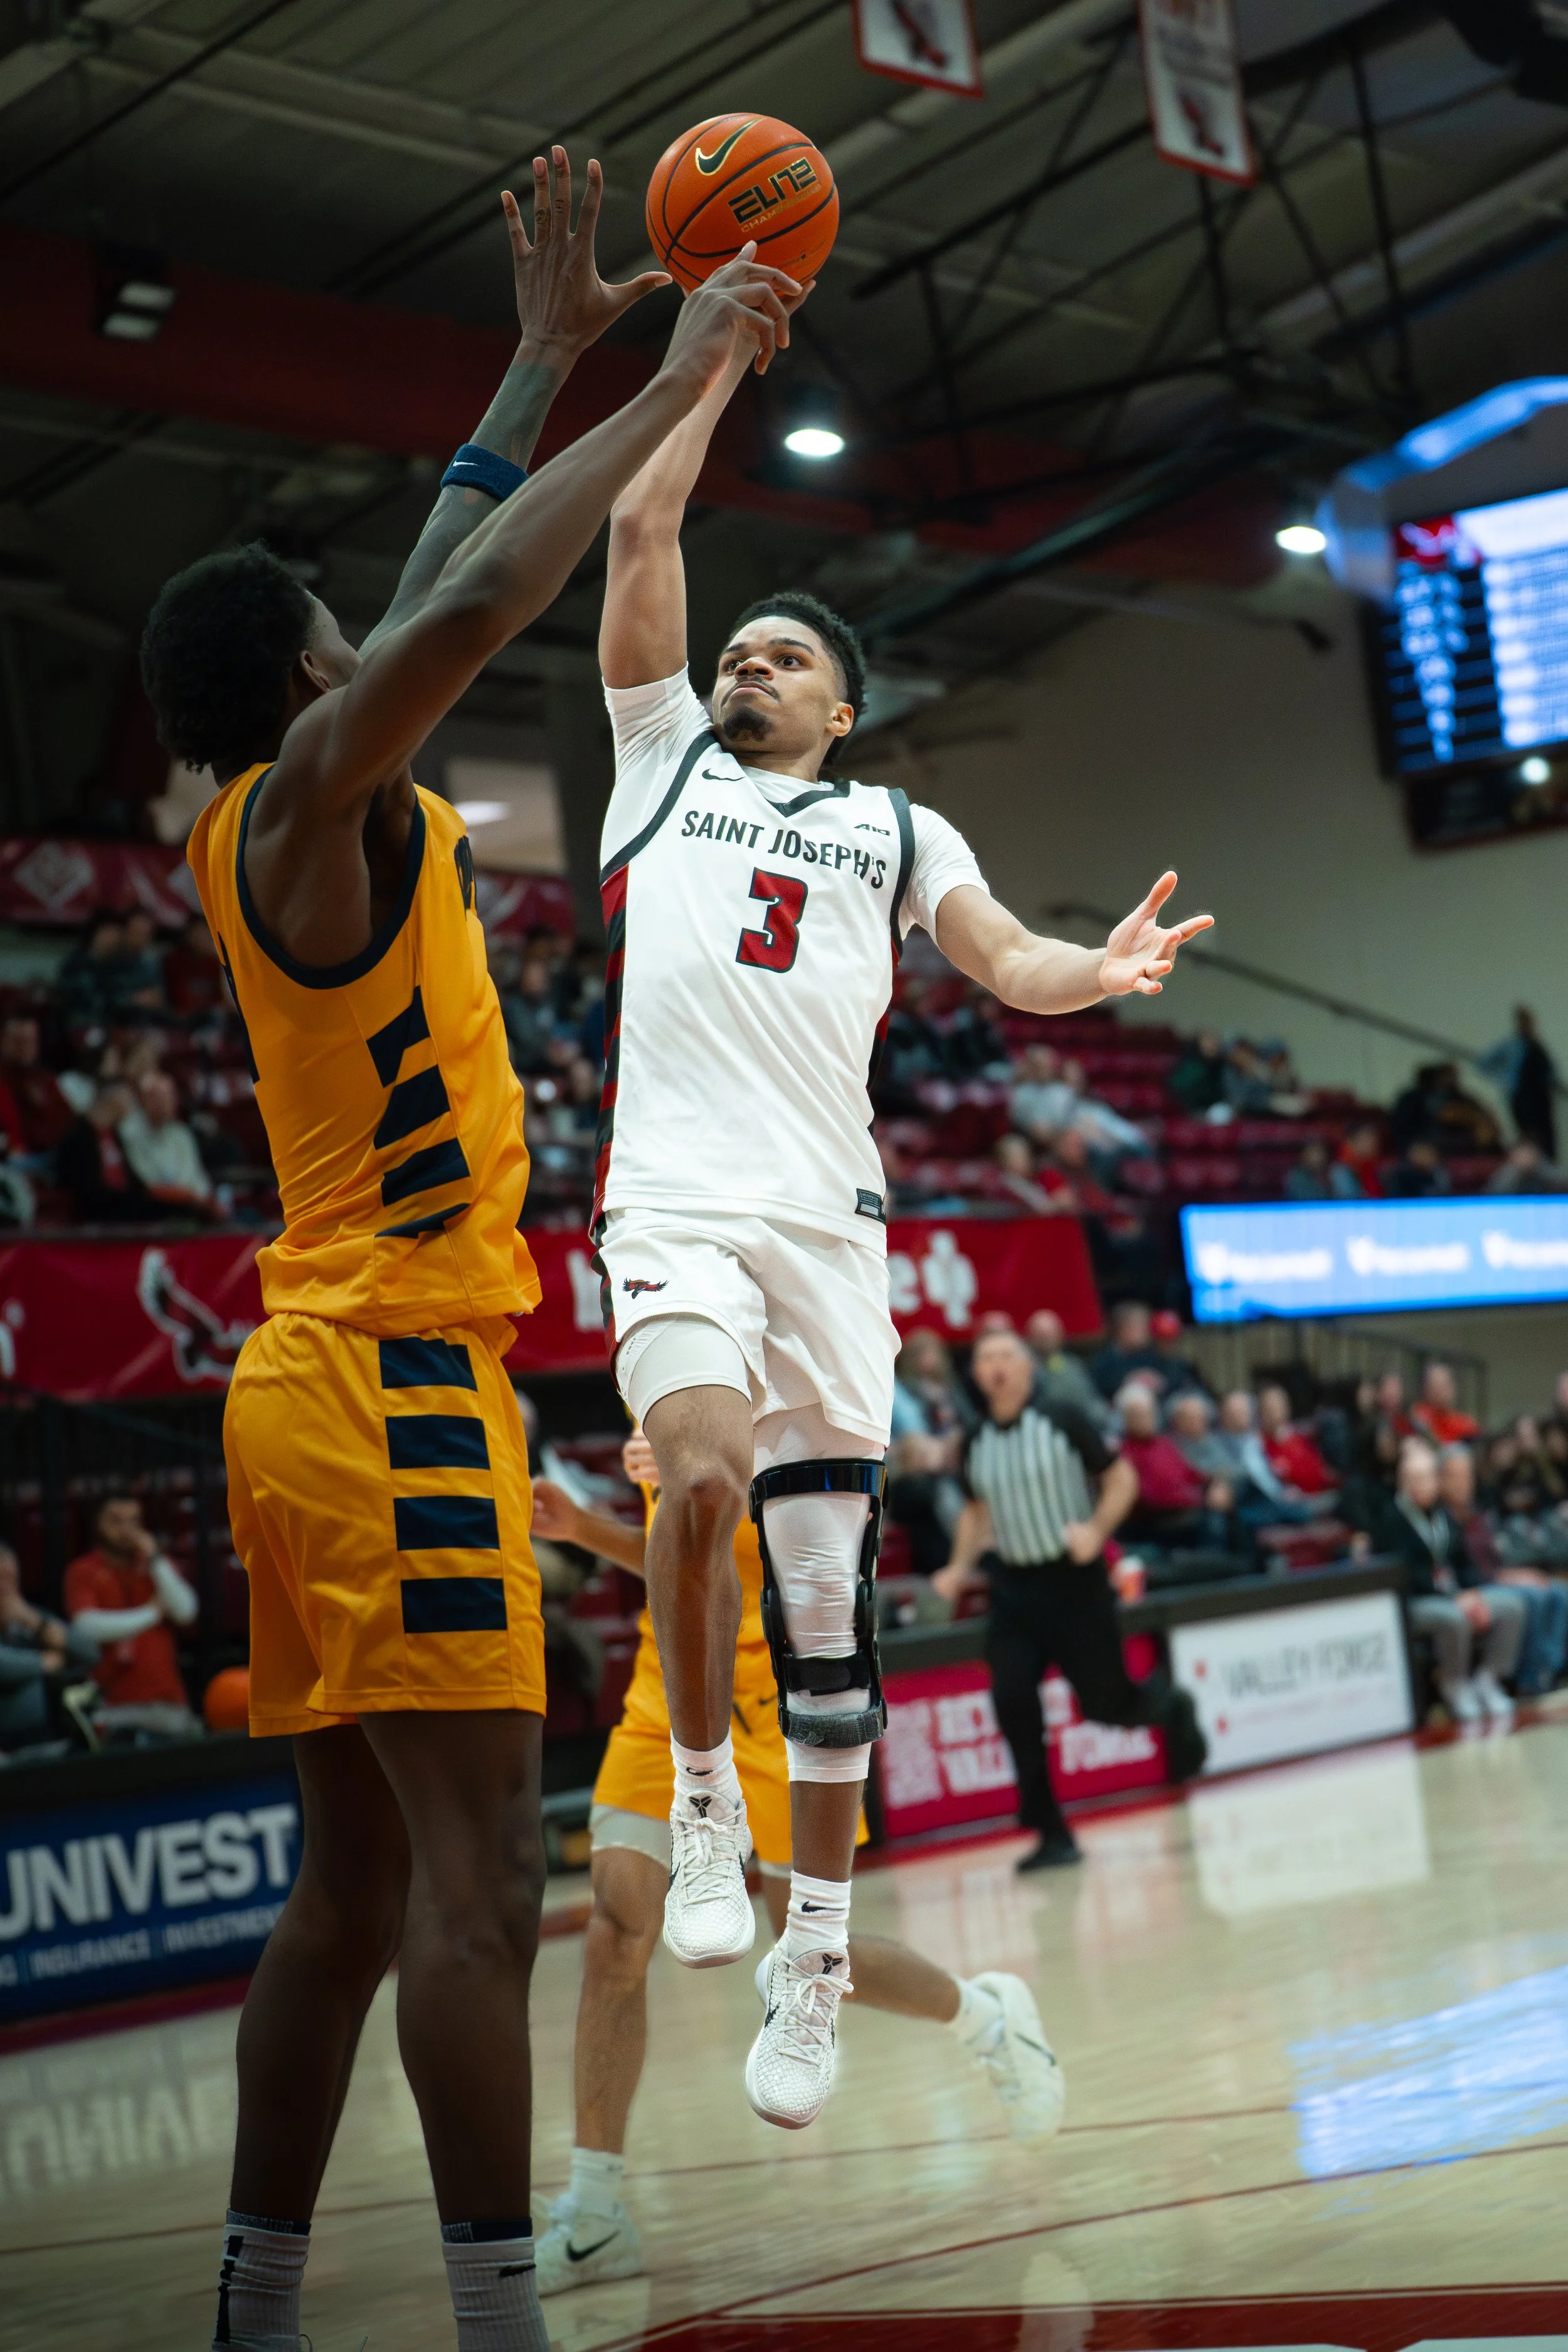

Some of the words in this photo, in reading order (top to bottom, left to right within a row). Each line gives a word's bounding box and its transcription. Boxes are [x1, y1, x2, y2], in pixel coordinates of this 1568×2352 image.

[728, 157, 818, 225] ELITE
[681, 810, 765, 849] SAINT
[768, 829, 887, 889] JOSEPH'S
[735, 867, 808, 973] 3
[1223, 1645, 1311, 1697] VALLEY
[0, 1802, 297, 1941] UNIVEST
